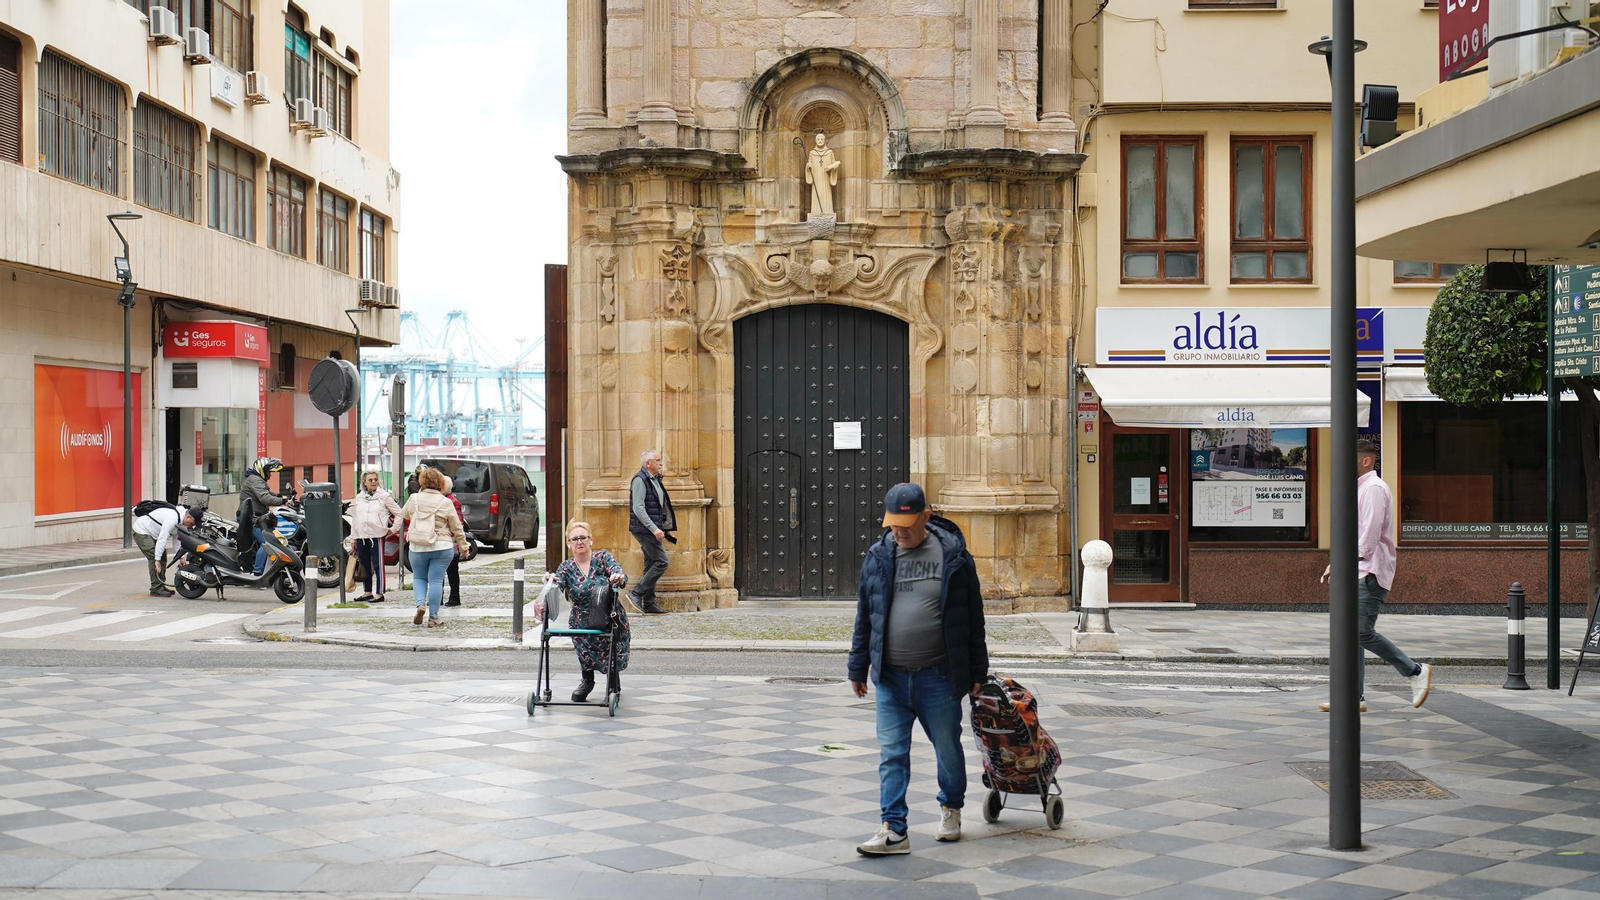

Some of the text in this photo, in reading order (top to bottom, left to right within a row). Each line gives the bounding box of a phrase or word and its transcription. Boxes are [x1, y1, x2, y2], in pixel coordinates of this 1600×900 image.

[192, 331, 209, 339] Ges
[1173, 311, 1259, 350] aldía
[192, 339, 226, 348] seguros
[1173, 353, 1260, 361] GRUPO INMOBILIARIO
[1554, 368, 1559, 376] de
[1217, 407, 1255, 422] aldía
[70, 430, 103, 446] AUDÍFONOS
[1434, 524, 1453, 532] JOSÉ
[894, 582, 914, 592] PARIS
